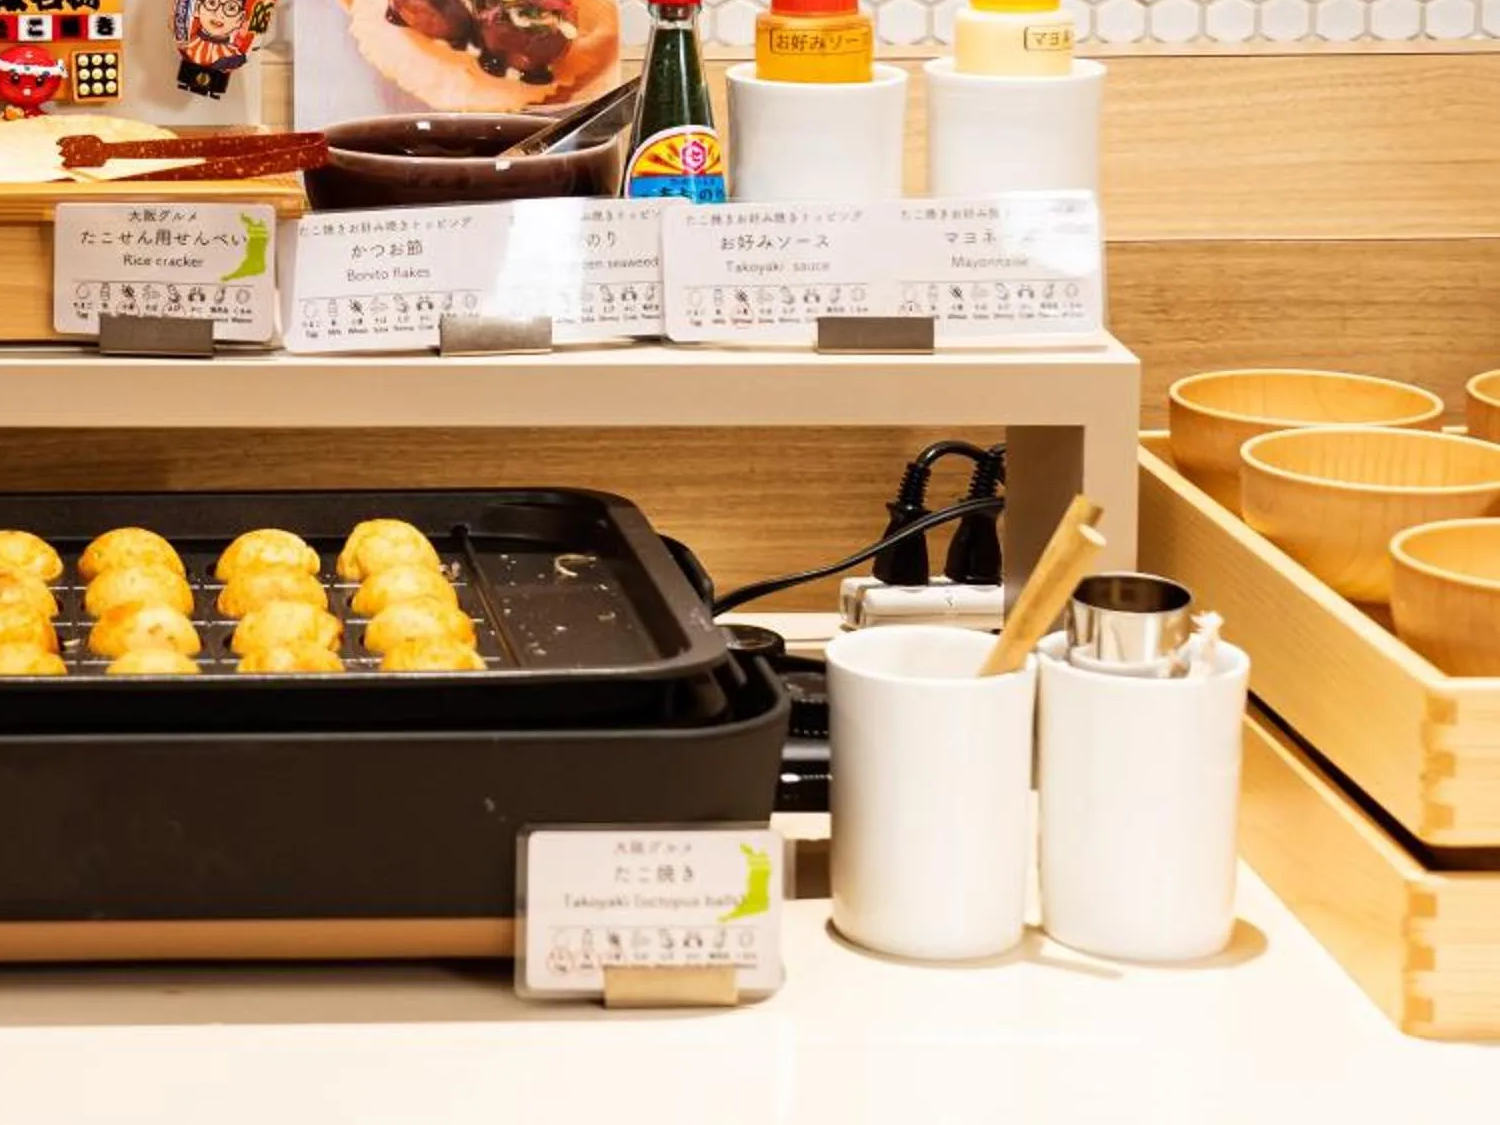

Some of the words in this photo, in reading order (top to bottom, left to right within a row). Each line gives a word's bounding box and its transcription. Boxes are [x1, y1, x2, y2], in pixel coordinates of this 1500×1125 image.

[80, 228, 247, 247] たこせん用せんべい
[720, 234, 830, 252] お好みソース
[351, 239, 424, 259] かつお節
[123, 254, 151, 267] Rice
[155, 255, 204, 268] cracker
[725, 260, 785, 275] Takoyaki
[792, 261, 831, 273] sauce
[347, 269, 389, 282] Bonito
[392, 267, 430, 279] flakes
[614, 864, 694, 884] たこ焼き
[563, 893, 630, 910] Takoyaki
